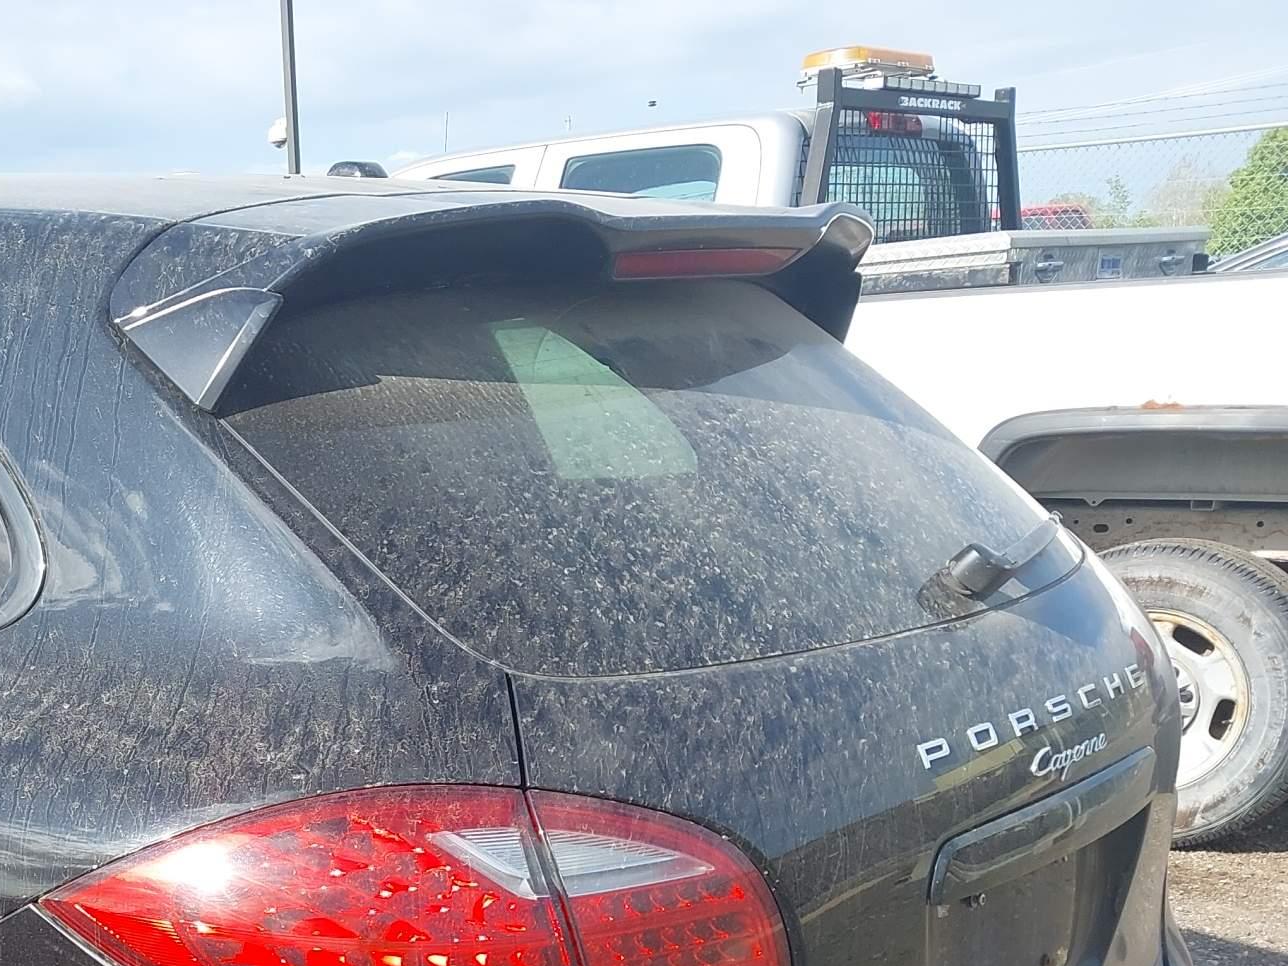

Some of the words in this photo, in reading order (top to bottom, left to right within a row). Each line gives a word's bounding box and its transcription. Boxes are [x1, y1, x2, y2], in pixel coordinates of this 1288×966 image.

[897, 96, 962, 111] BACKRACK
[916, 663, 1149, 770] PORSCHE
[1029, 731, 1108, 782] Cayenne
